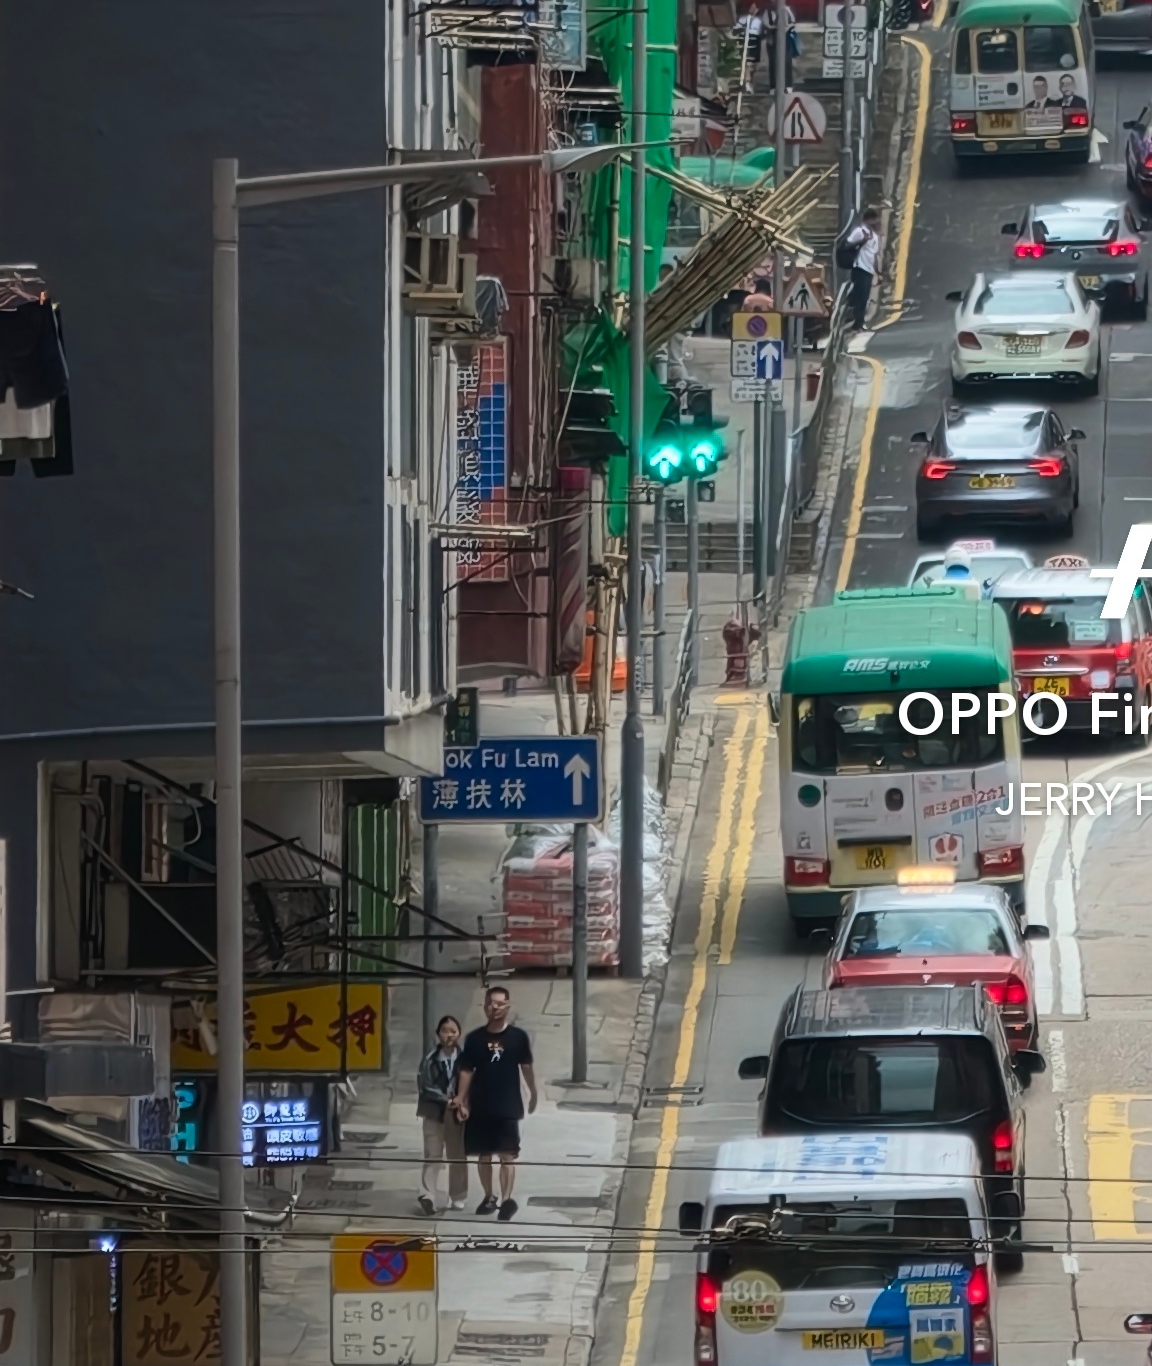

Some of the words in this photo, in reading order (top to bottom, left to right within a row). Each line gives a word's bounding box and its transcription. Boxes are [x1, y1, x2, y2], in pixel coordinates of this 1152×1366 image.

[446, 748, 473, 769] ok
[481, 748, 506, 769] Fu
[515, 748, 559, 769] Lam
[432, 778, 526, 809] 薄扶林
[371, 1301, 430, 1322] 8-10
[372, 1335, 416, 1356] 5-7
[811, 1332, 876, 1349] MEIRIKI
